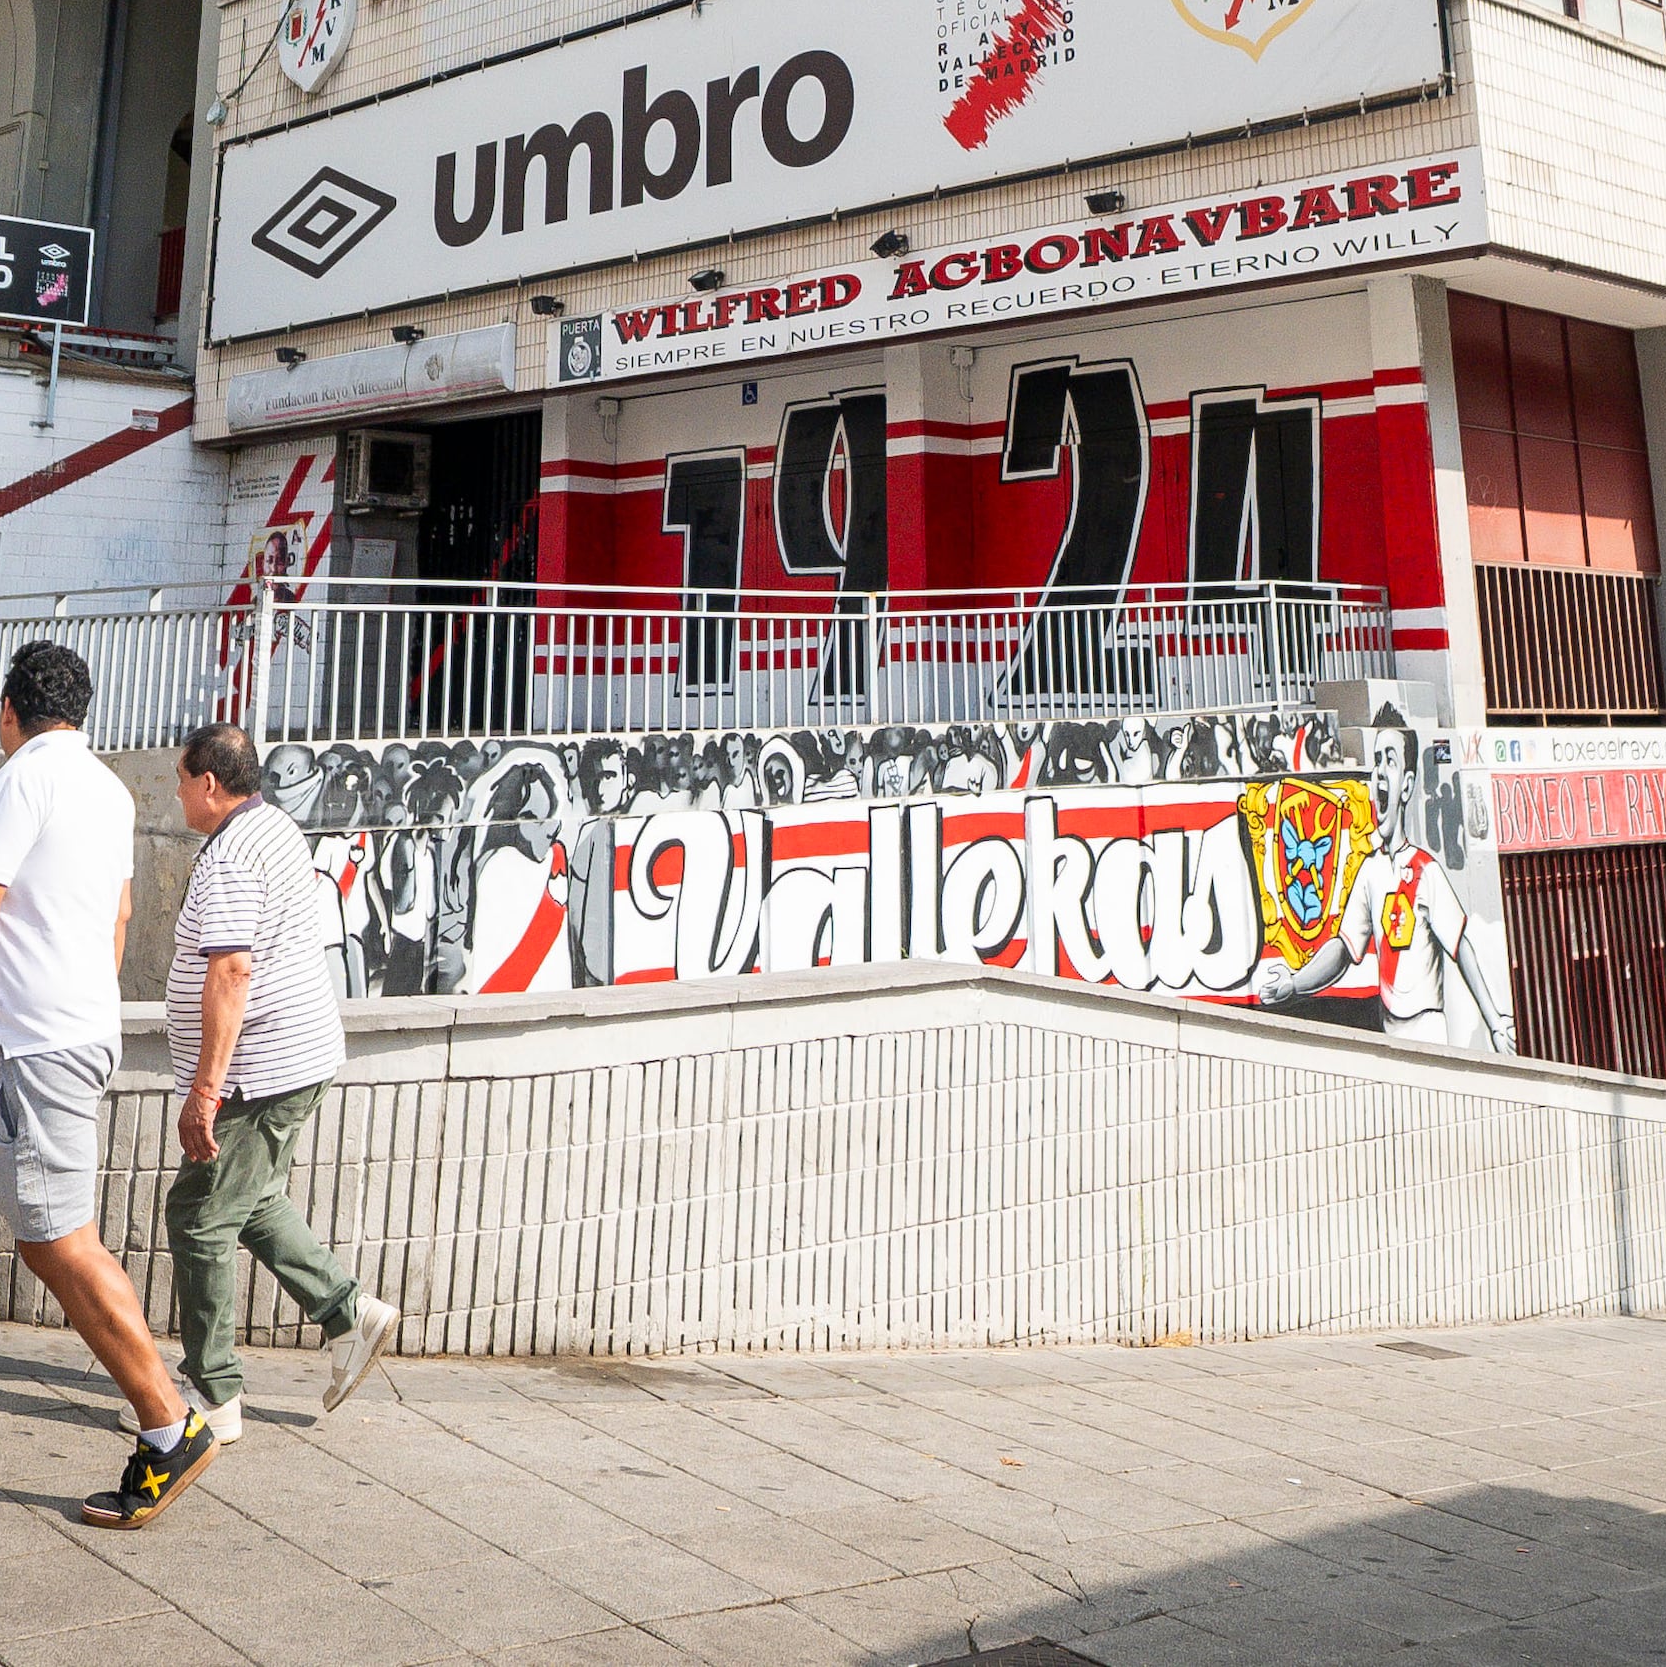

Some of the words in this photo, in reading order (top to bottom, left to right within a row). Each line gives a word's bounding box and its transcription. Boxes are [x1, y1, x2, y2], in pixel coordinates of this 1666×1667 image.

[937, 8, 1012, 39] OFICIAL
[937, 10, 1074, 57] RAYO
[938, 28, 1075, 74] VALLECANO
[939, 74, 964, 93] DE
[985, 47, 1075, 81] MADRID
[434, 50, 854, 247] umbro
[611, 273, 862, 344] WILFRED
[615, 342, 727, 372] SIEMPRE
[741, 335, 775, 353] EN
[791, 309, 930, 347] NUESTRO
[947, 275, 1136, 320] RECUERDO
[1161, 246, 1320, 285] ETERNO
[1332, 221, 1460, 258] WILLY
[562, 318, 601, 335] PUERTA
[1491, 777, 1577, 844] BOXEO
[1583, 774, 1619, 837] EL
